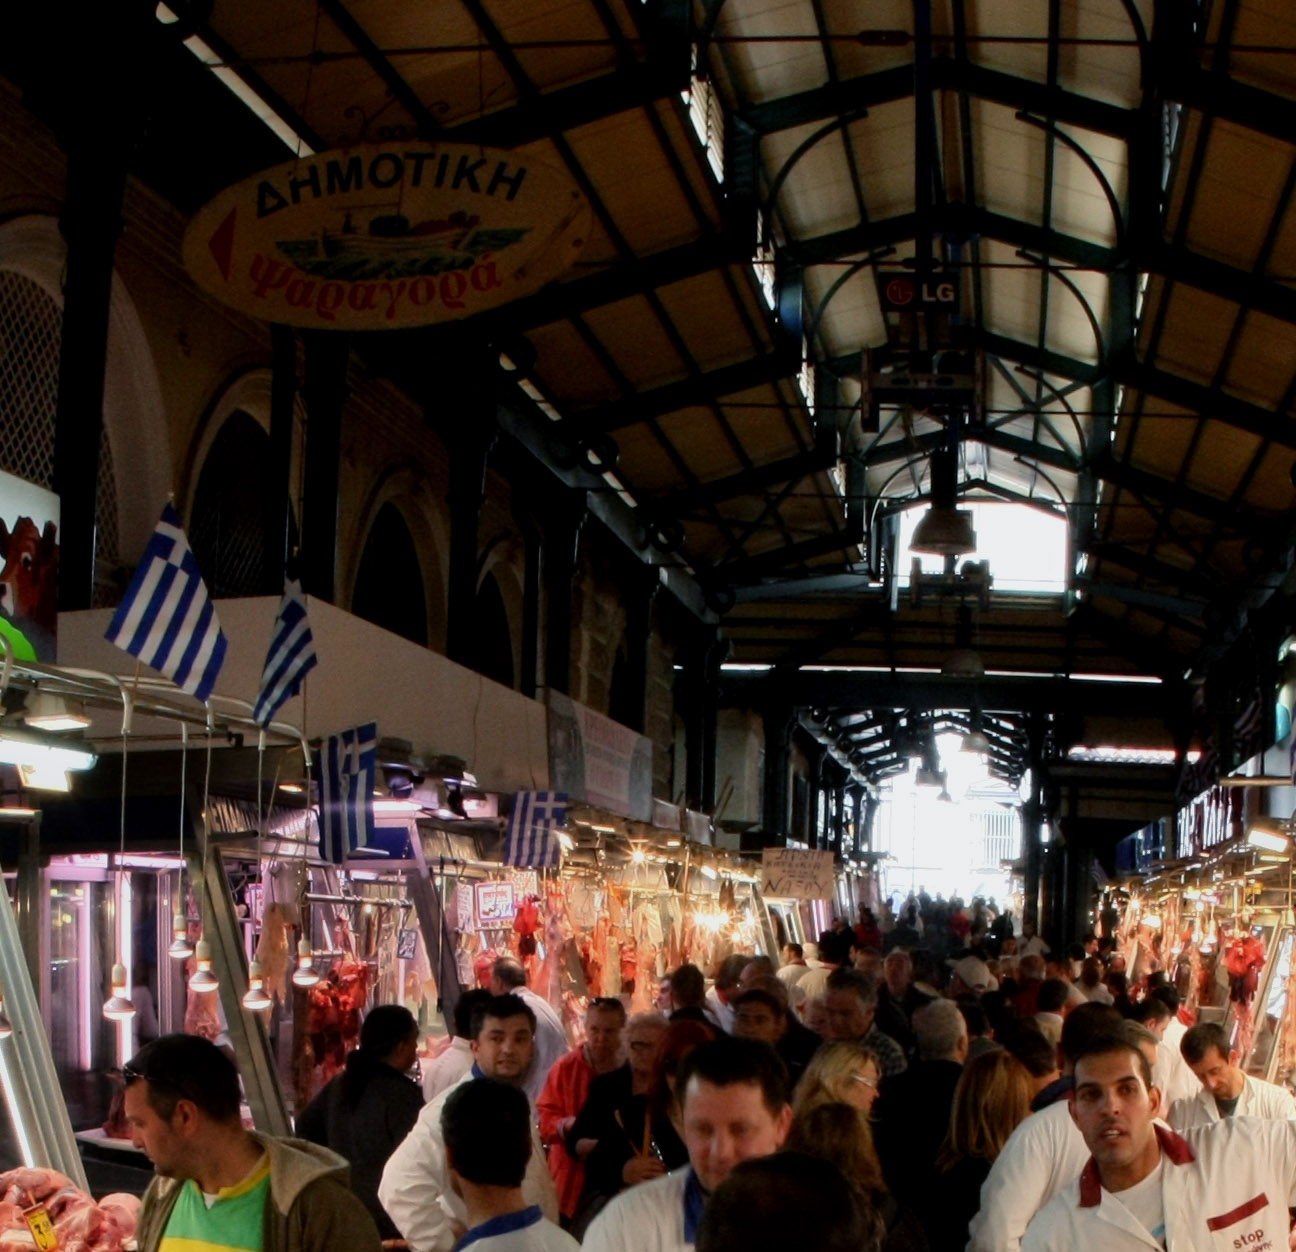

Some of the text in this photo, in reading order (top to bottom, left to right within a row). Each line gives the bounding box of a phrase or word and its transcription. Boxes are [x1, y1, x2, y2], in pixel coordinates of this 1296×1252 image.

[256, 151, 528, 219] ΔΗΜΟΤΙΚΗ
[248, 252, 503, 321] Ψαραγορά
[921, 282, 955, 302] LG
[1232, 1229, 1264, 1249] stop
